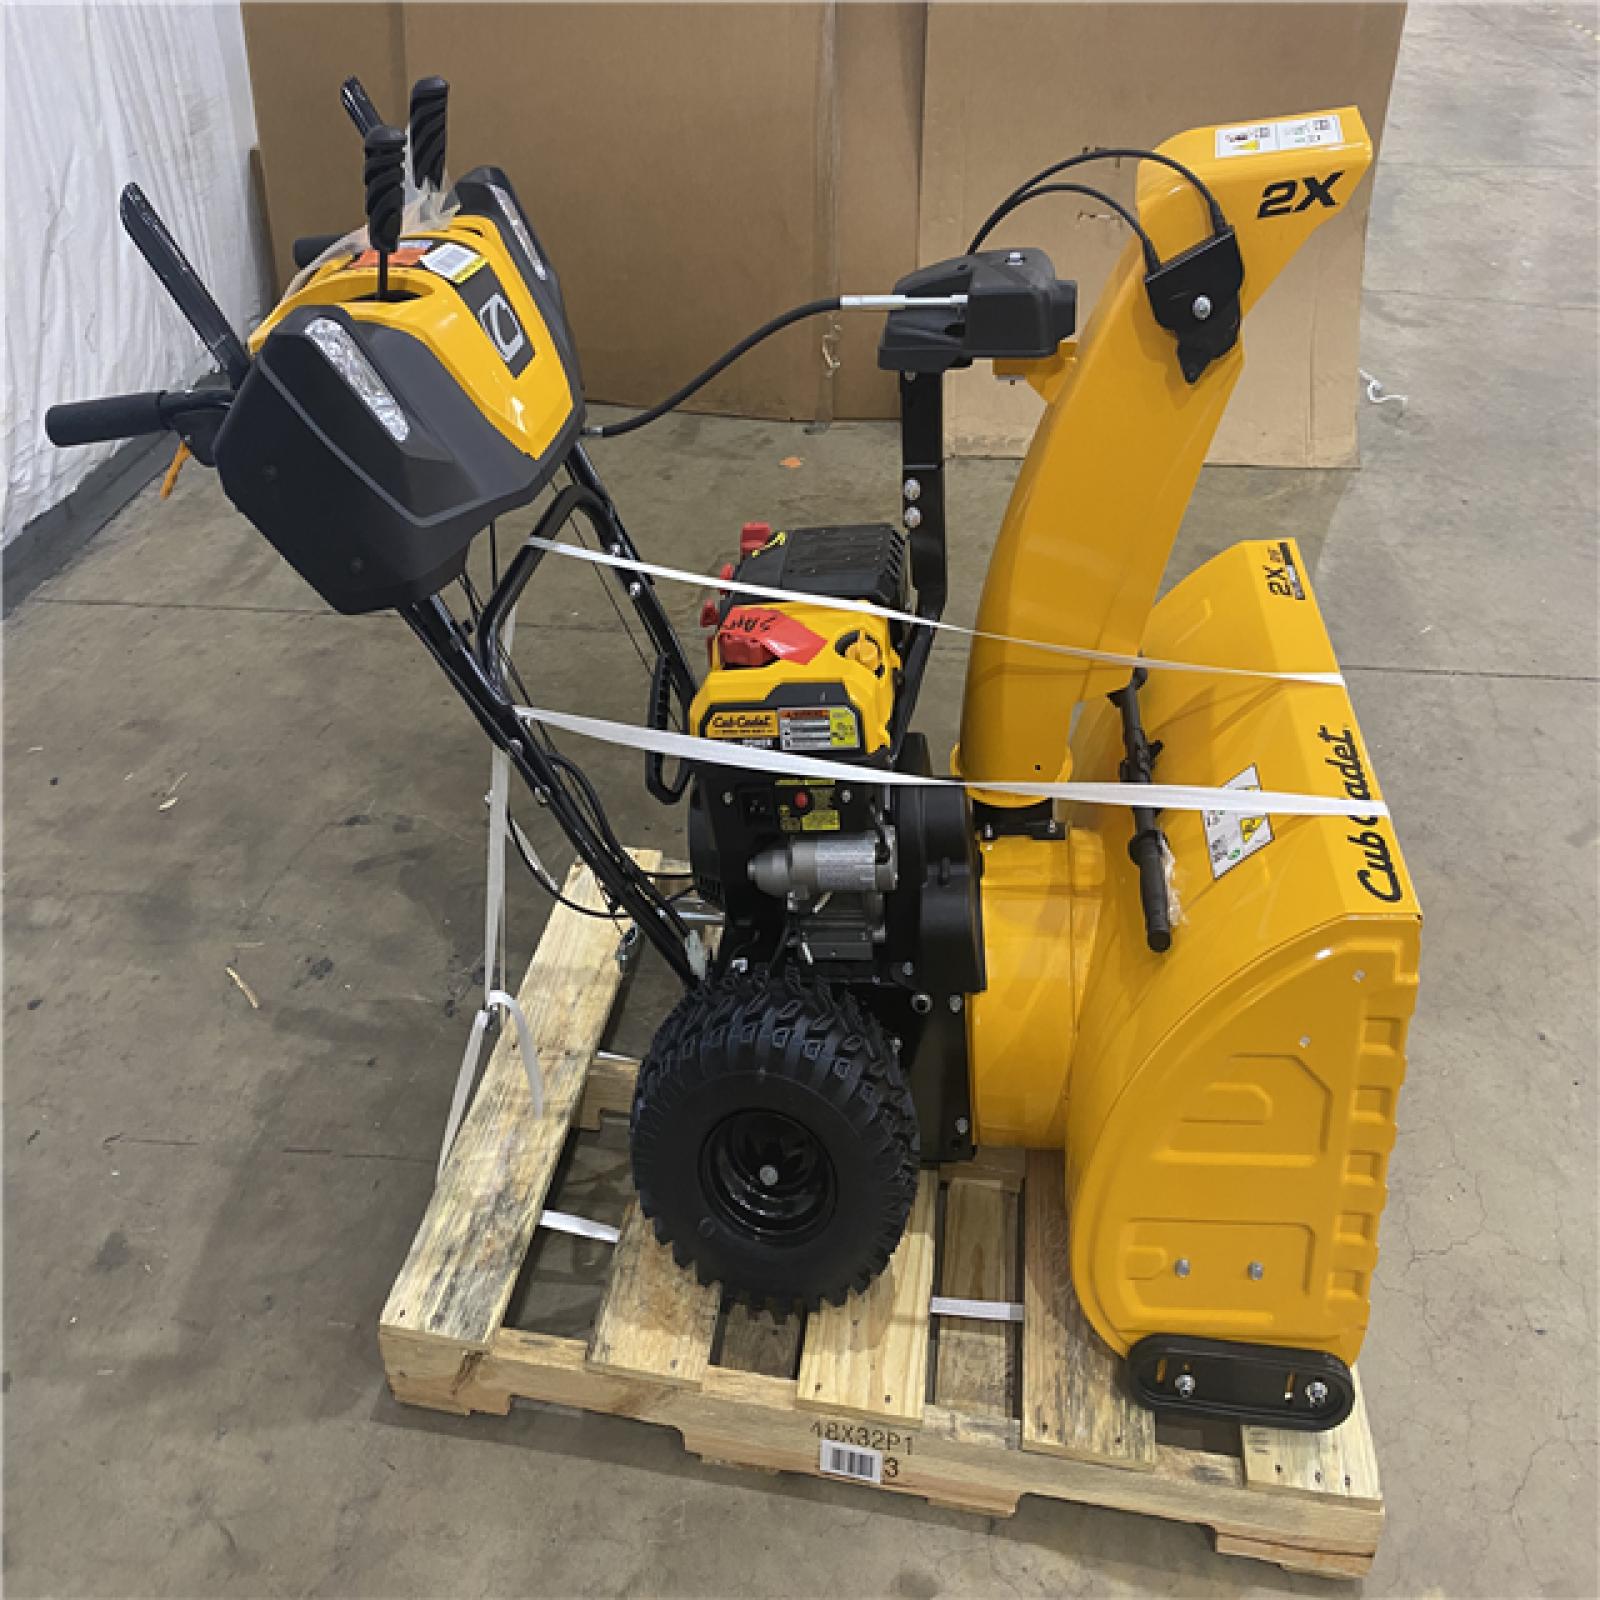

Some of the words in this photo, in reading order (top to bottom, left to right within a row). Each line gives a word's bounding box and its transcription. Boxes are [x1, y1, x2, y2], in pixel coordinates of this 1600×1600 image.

[1257, 170, 1346, 219] 2X
[1263, 565, 1291, 596] 2X
[1346, 831, 1403, 903] Cub
